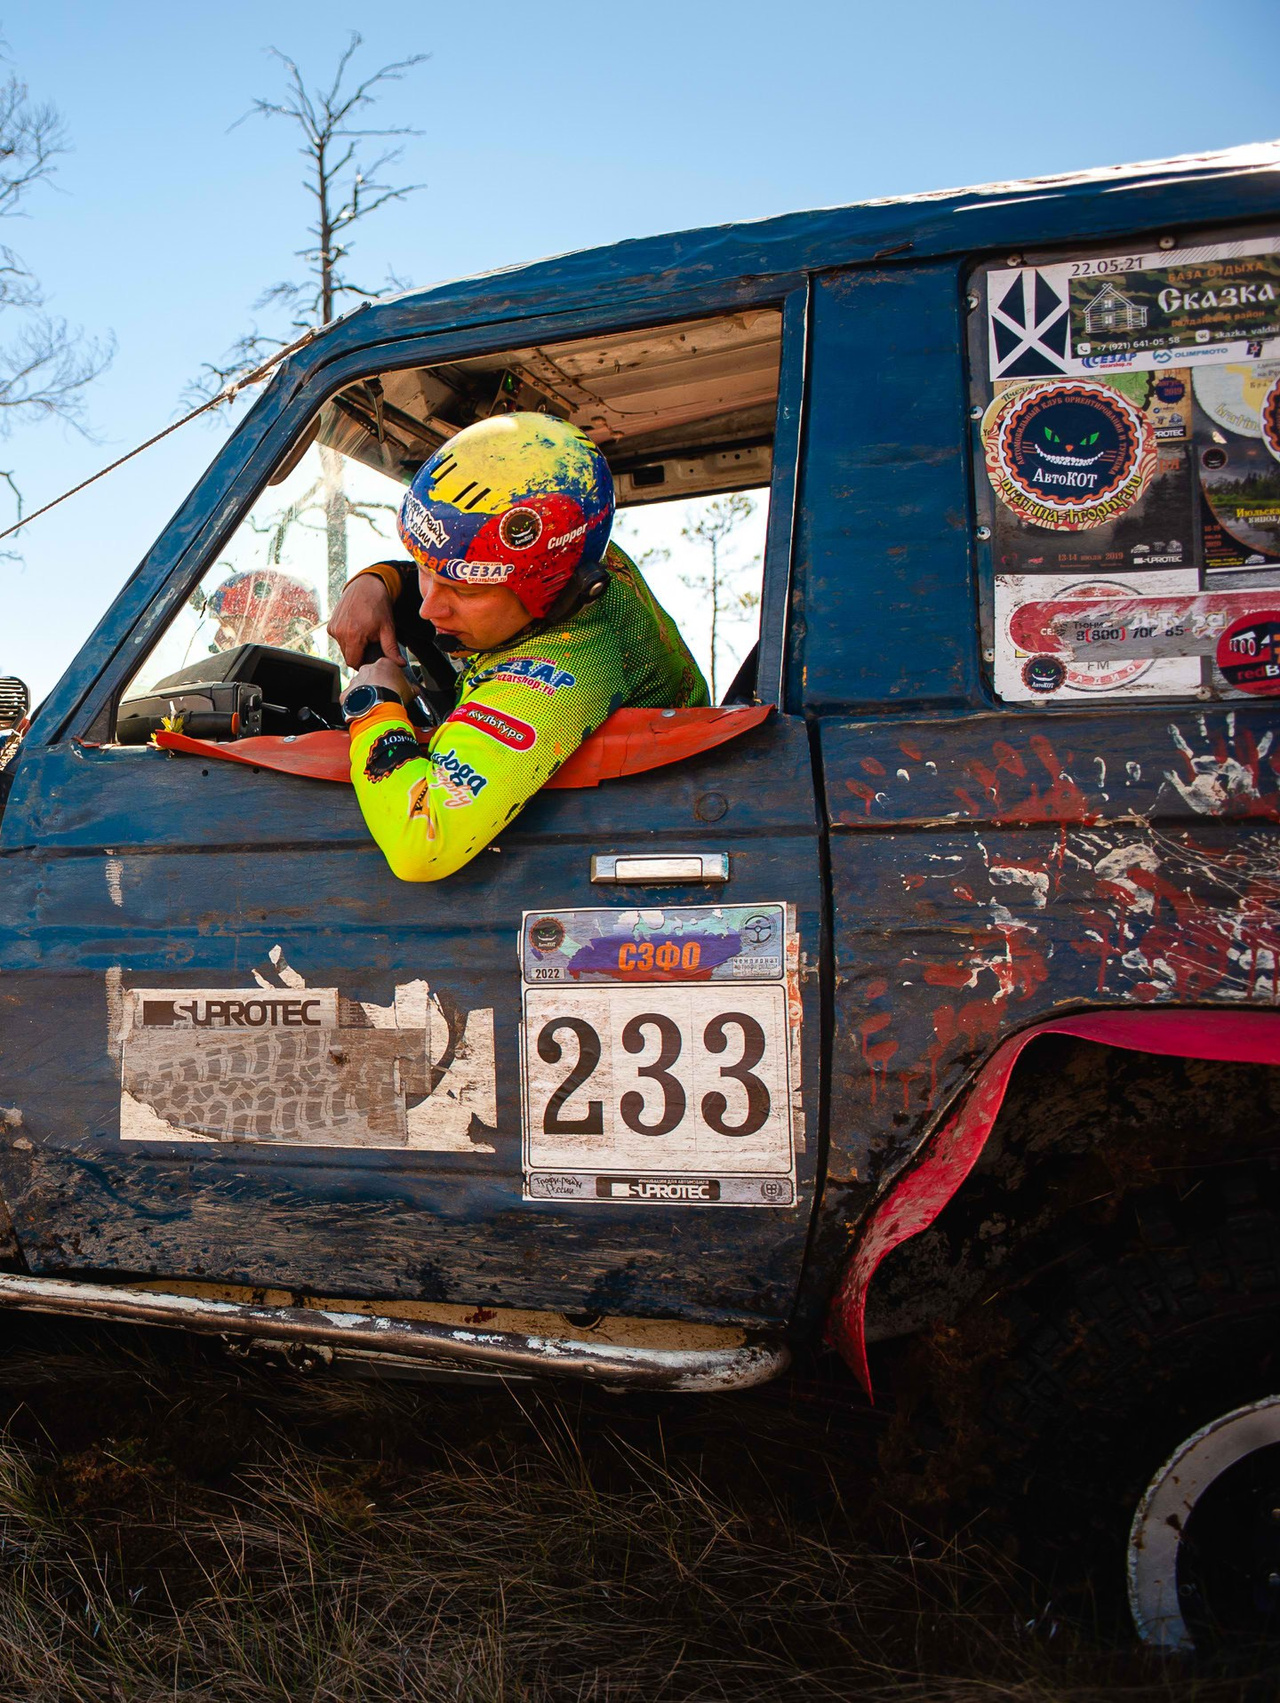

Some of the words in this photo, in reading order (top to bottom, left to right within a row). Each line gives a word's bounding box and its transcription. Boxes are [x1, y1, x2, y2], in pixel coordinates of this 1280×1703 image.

[1071, 256, 1144, 276] 22.05.21
[1168, 270, 1202, 283] БАЗА
[1032, 467, 1098, 489] АвтоКОТ
[547, 522, 588, 550] Cupper
[460, 563, 514, 578] СЕЗАР
[496, 673, 557, 697] ezarshop.ru
[618, 941, 701, 972] СЗФО
[535, 968, 560, 979] 2022
[172, 999, 321, 1027] SUPROTEC
[536, 1011, 771, 1137] 233
[627, 1183, 710, 1199] SUPROTEC
